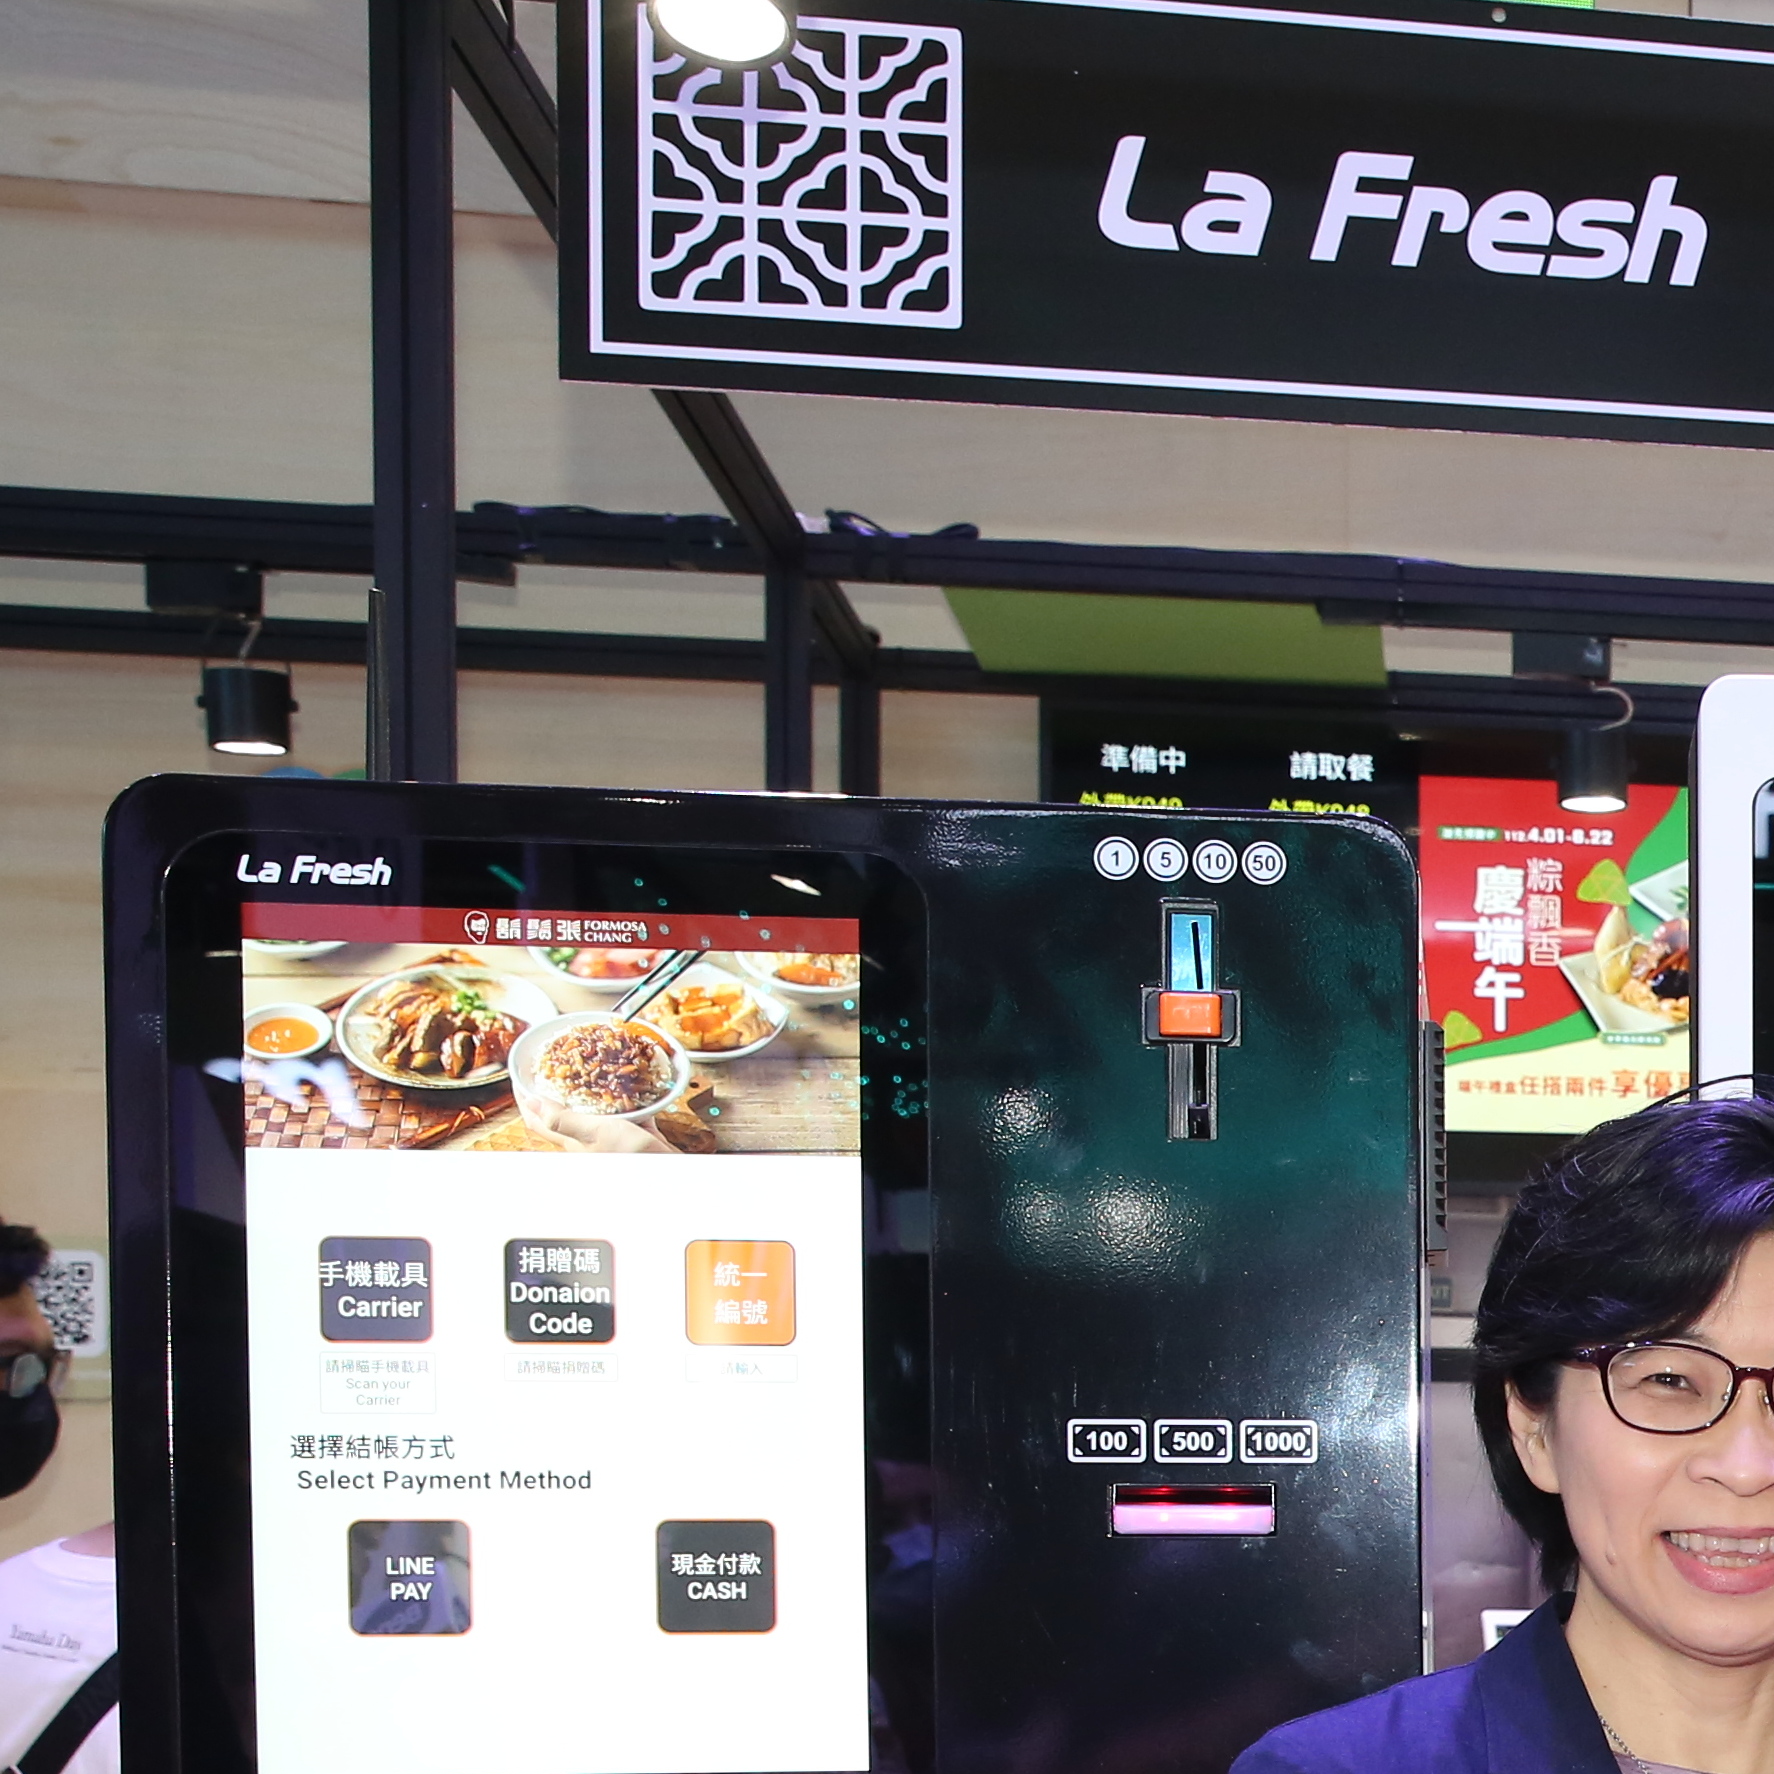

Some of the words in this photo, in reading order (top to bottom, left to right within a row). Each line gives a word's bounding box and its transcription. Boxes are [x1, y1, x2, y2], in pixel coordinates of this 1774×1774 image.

[1098, 136, 1271, 257] La
[1310, 150, 1708, 287] Fresh
[1101, 743, 1186, 774] 準備中
[1290, 751, 1374, 782] 請取餐
[237, 854, 281, 884] La
[289, 855, 392, 887] Fresh
[1113, 852, 1121, 866] 1
[1160, 852, 1172, 868] 5
[1203, 854, 1226, 870] 10
[1252, 855, 1276, 871] 50
[1526, 857, 1564, 967] 粽飄香
[496, 918, 581, 941] 鬍鬚張
[584, 920, 647, 932] FORMOSA
[584, 932, 632, 943] CHANG
[1472, 865, 1526, 1033] 慶端午
[519, 1246, 601, 1274] 捐贈碼
[319, 1261, 428, 1288] 手機載具
[713, 1262, 768, 1288] 統一
[510, 1281, 611, 1306] Donaion
[337, 1296, 423, 1319] Carrier
[713, 1300, 768, 1326] 編號
[528, 1312, 593, 1335] Code
[345, 1377, 378, 1391] Scan
[382, 1378, 411, 1392] your
[356, 1393, 401, 1406] Carrier
[289, 1434, 456, 1463] 選擇結帳方式
[1085, 1431, 1128, 1452] 100
[1171, 1431, 1215, 1452] 500
[1251, 1431, 1306, 1453] 1000
[297, 1469, 376, 1492] Select
[383, 1470, 492, 1496] Payment
[499, 1469, 592, 1492] Method
[385, 1556, 435, 1576] LINE
[671, 1553, 762, 1576] 現金付款
[389, 1581, 432, 1602] PAY
[686, 1581, 748, 1602] CASH
